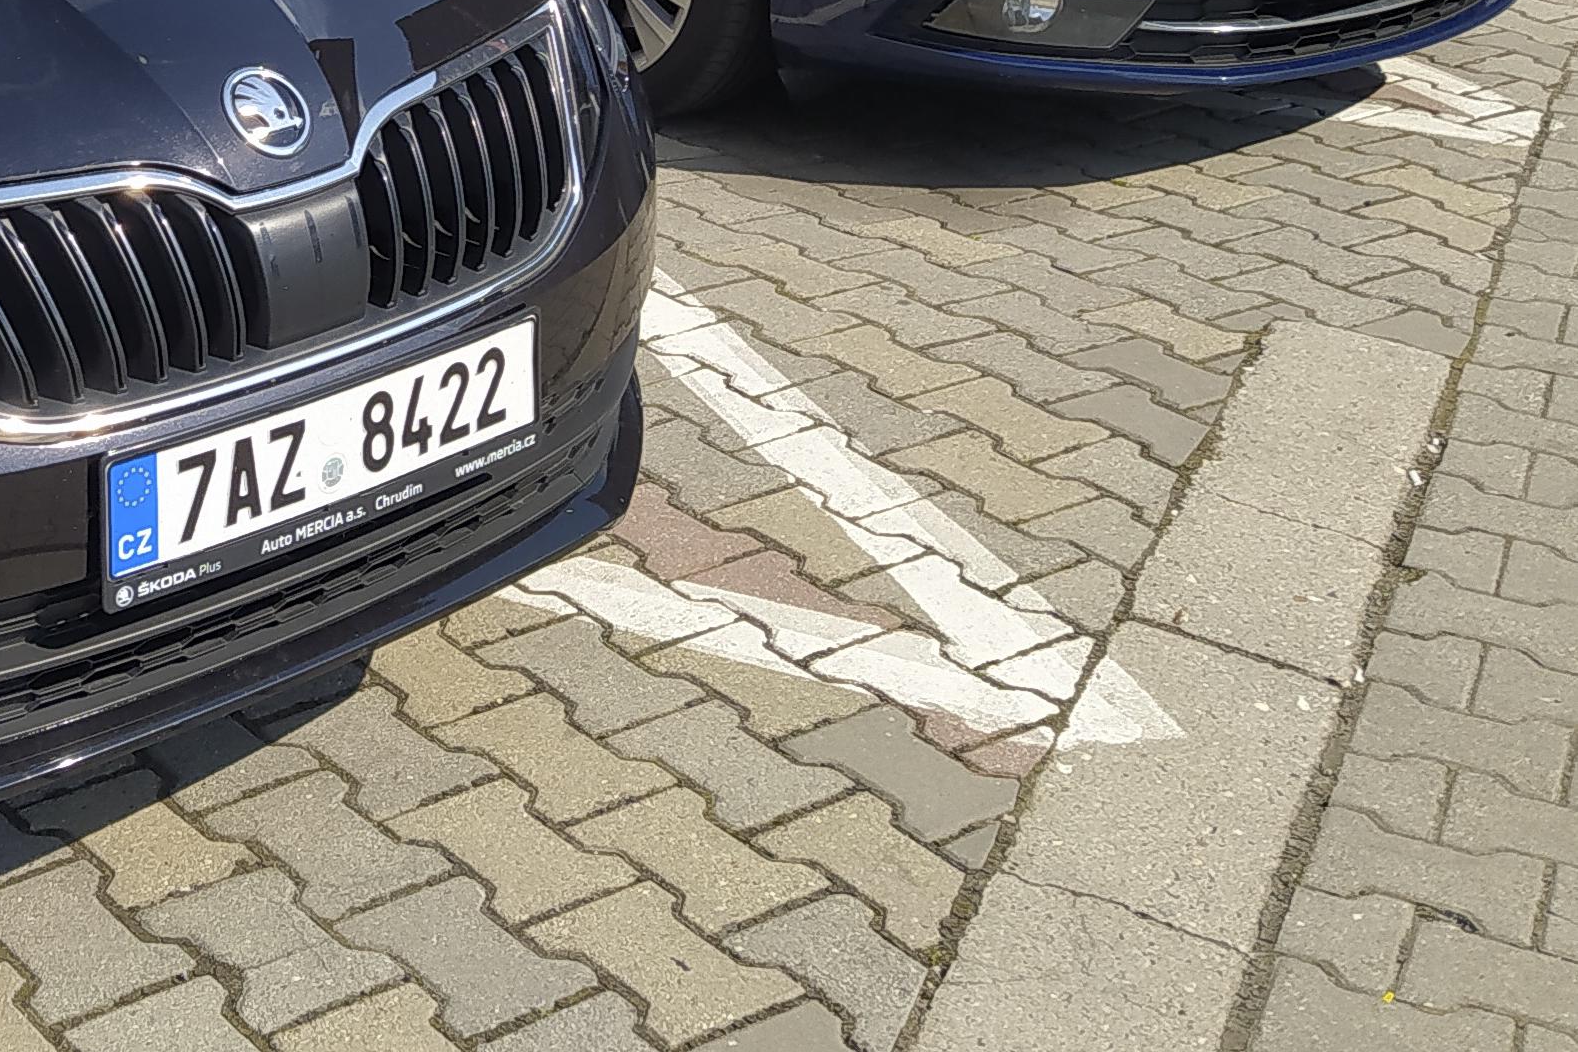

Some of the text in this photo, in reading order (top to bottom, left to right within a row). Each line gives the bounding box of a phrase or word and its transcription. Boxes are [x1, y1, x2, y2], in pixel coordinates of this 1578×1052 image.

[177, 346, 507, 545] 7AZ 8422
[454, 433, 536, 478] www.mercia.cz
[261, 483, 423, 555] Auto MERCIA a.s. Chrudim
[118, 528, 153, 560] CZ
[137, 560, 222, 598] ŠKODA Plus
